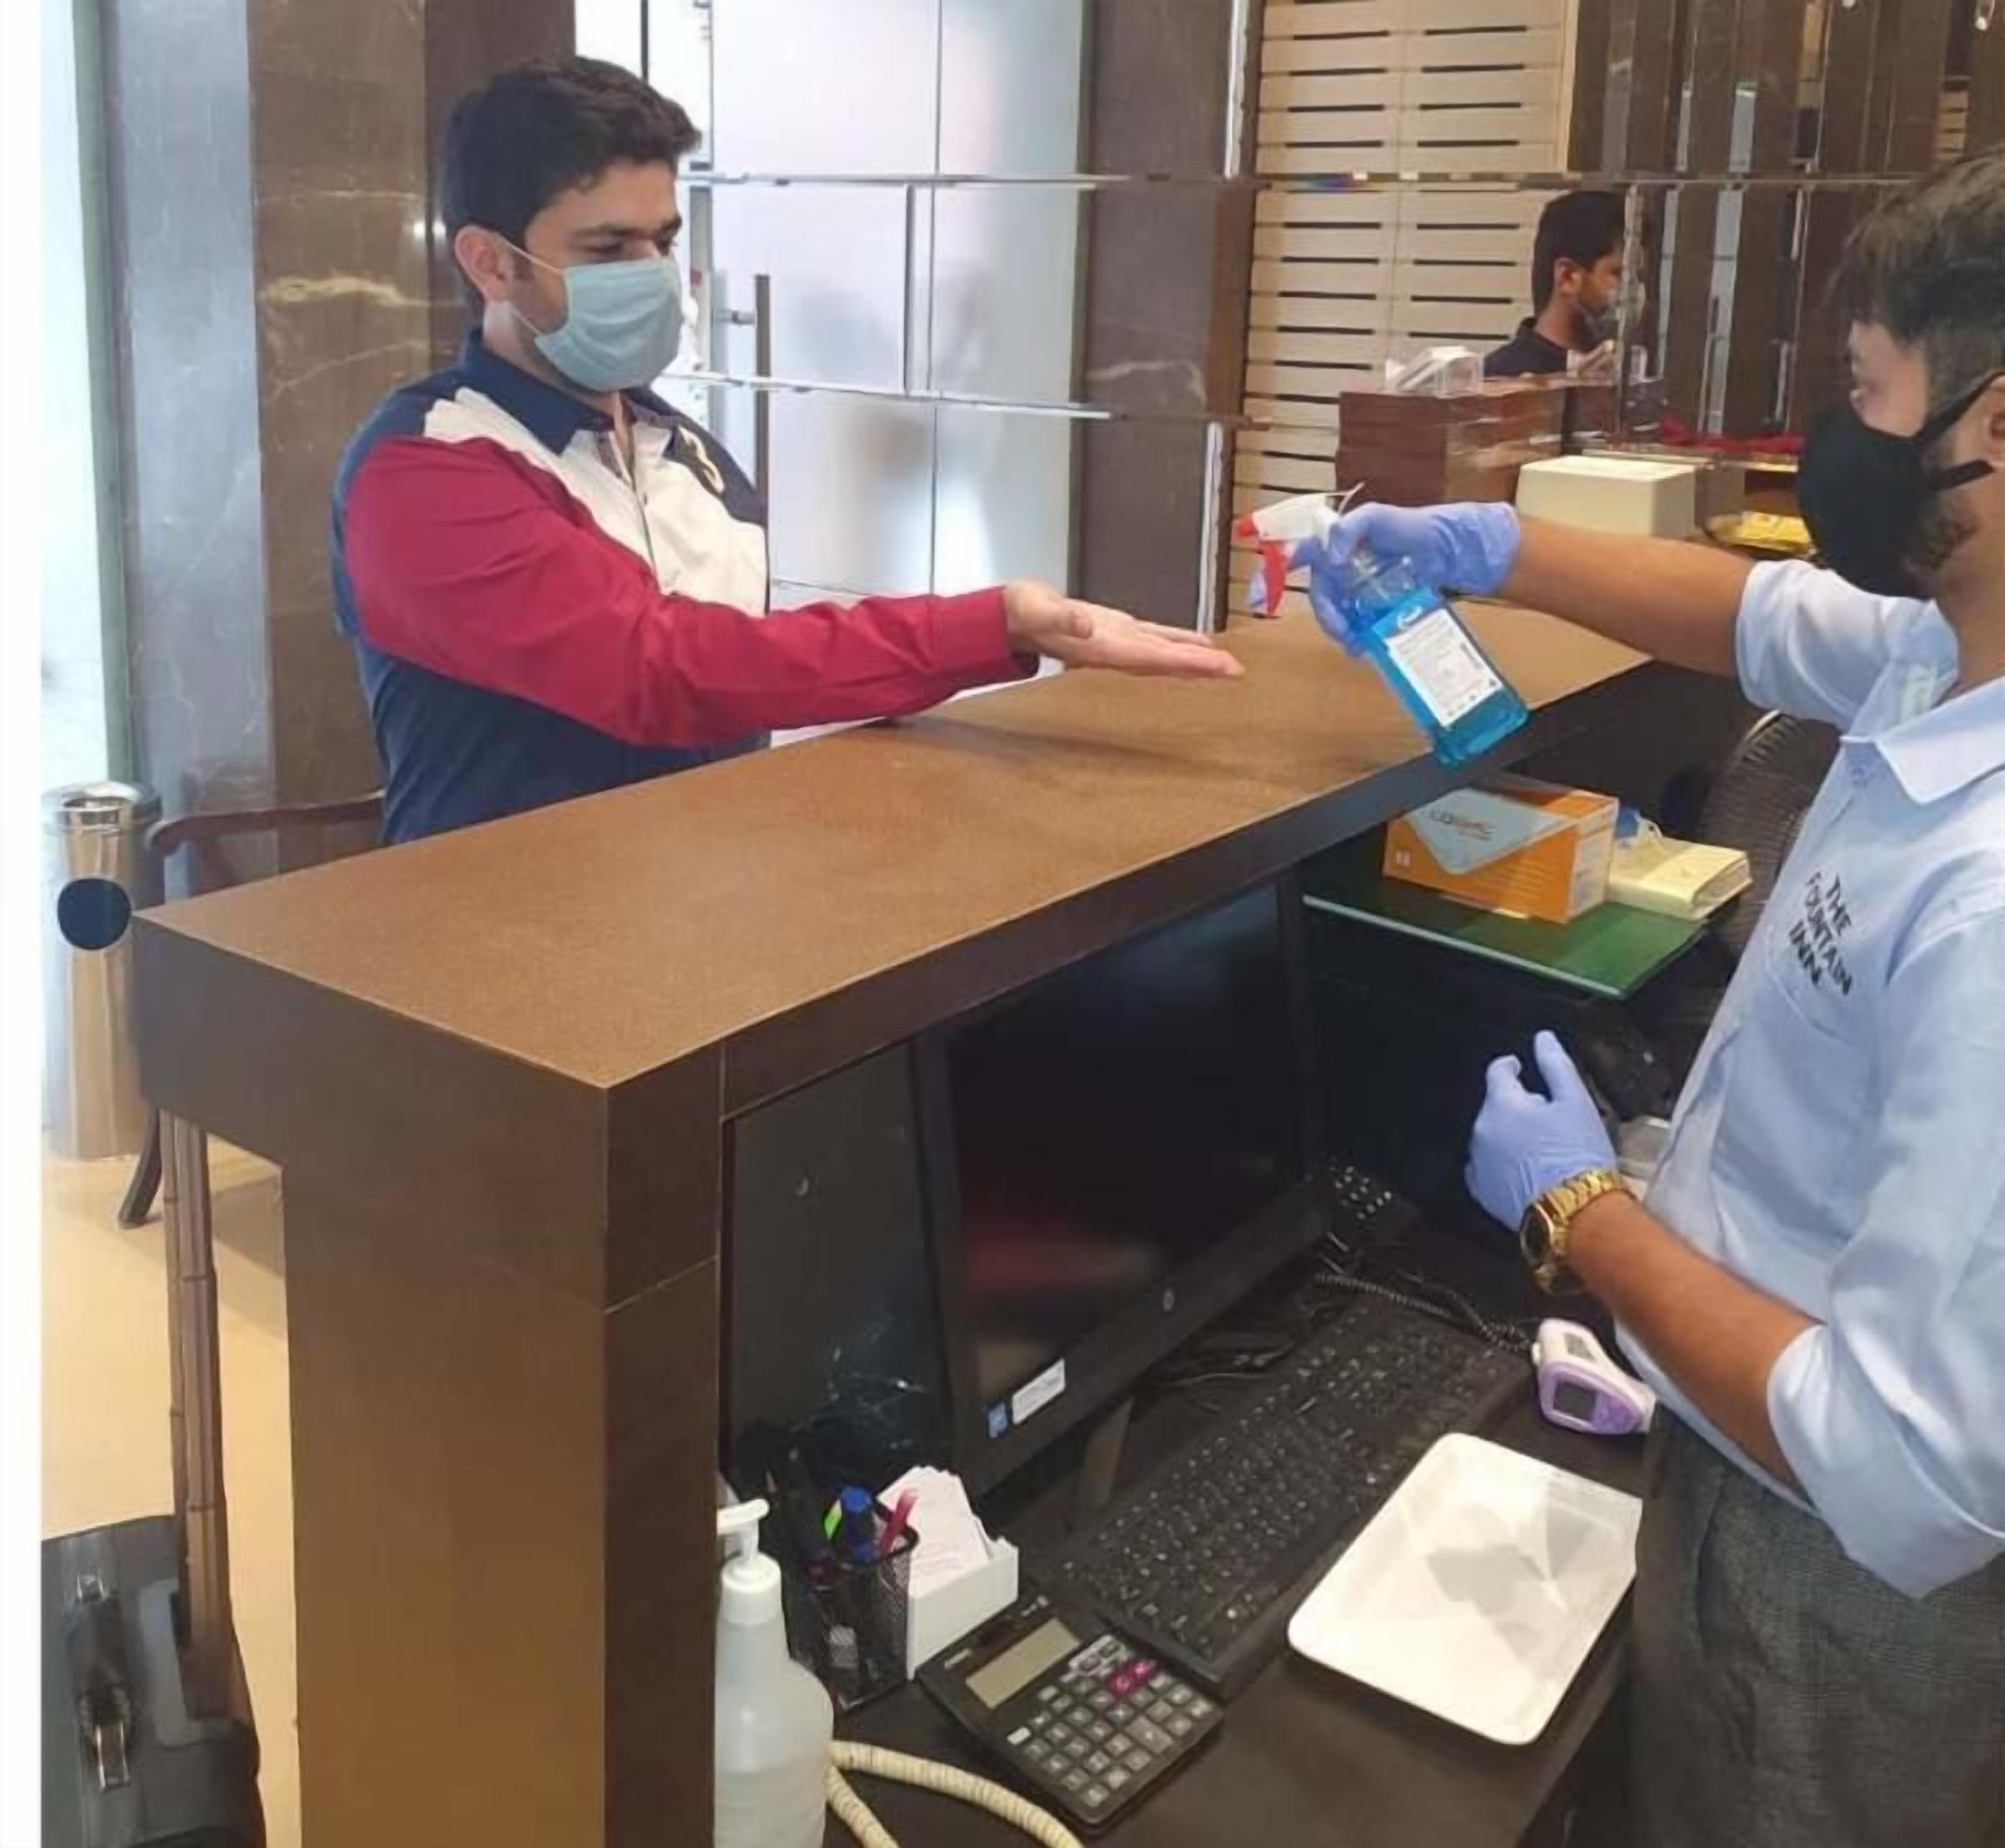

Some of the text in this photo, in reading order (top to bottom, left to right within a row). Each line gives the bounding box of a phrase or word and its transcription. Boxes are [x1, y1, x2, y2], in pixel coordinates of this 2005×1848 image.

[1805, 871, 1852, 996] FOUNTAIN
[1826, 873, 1852, 936] THE
[1788, 919, 1821, 986] INN
